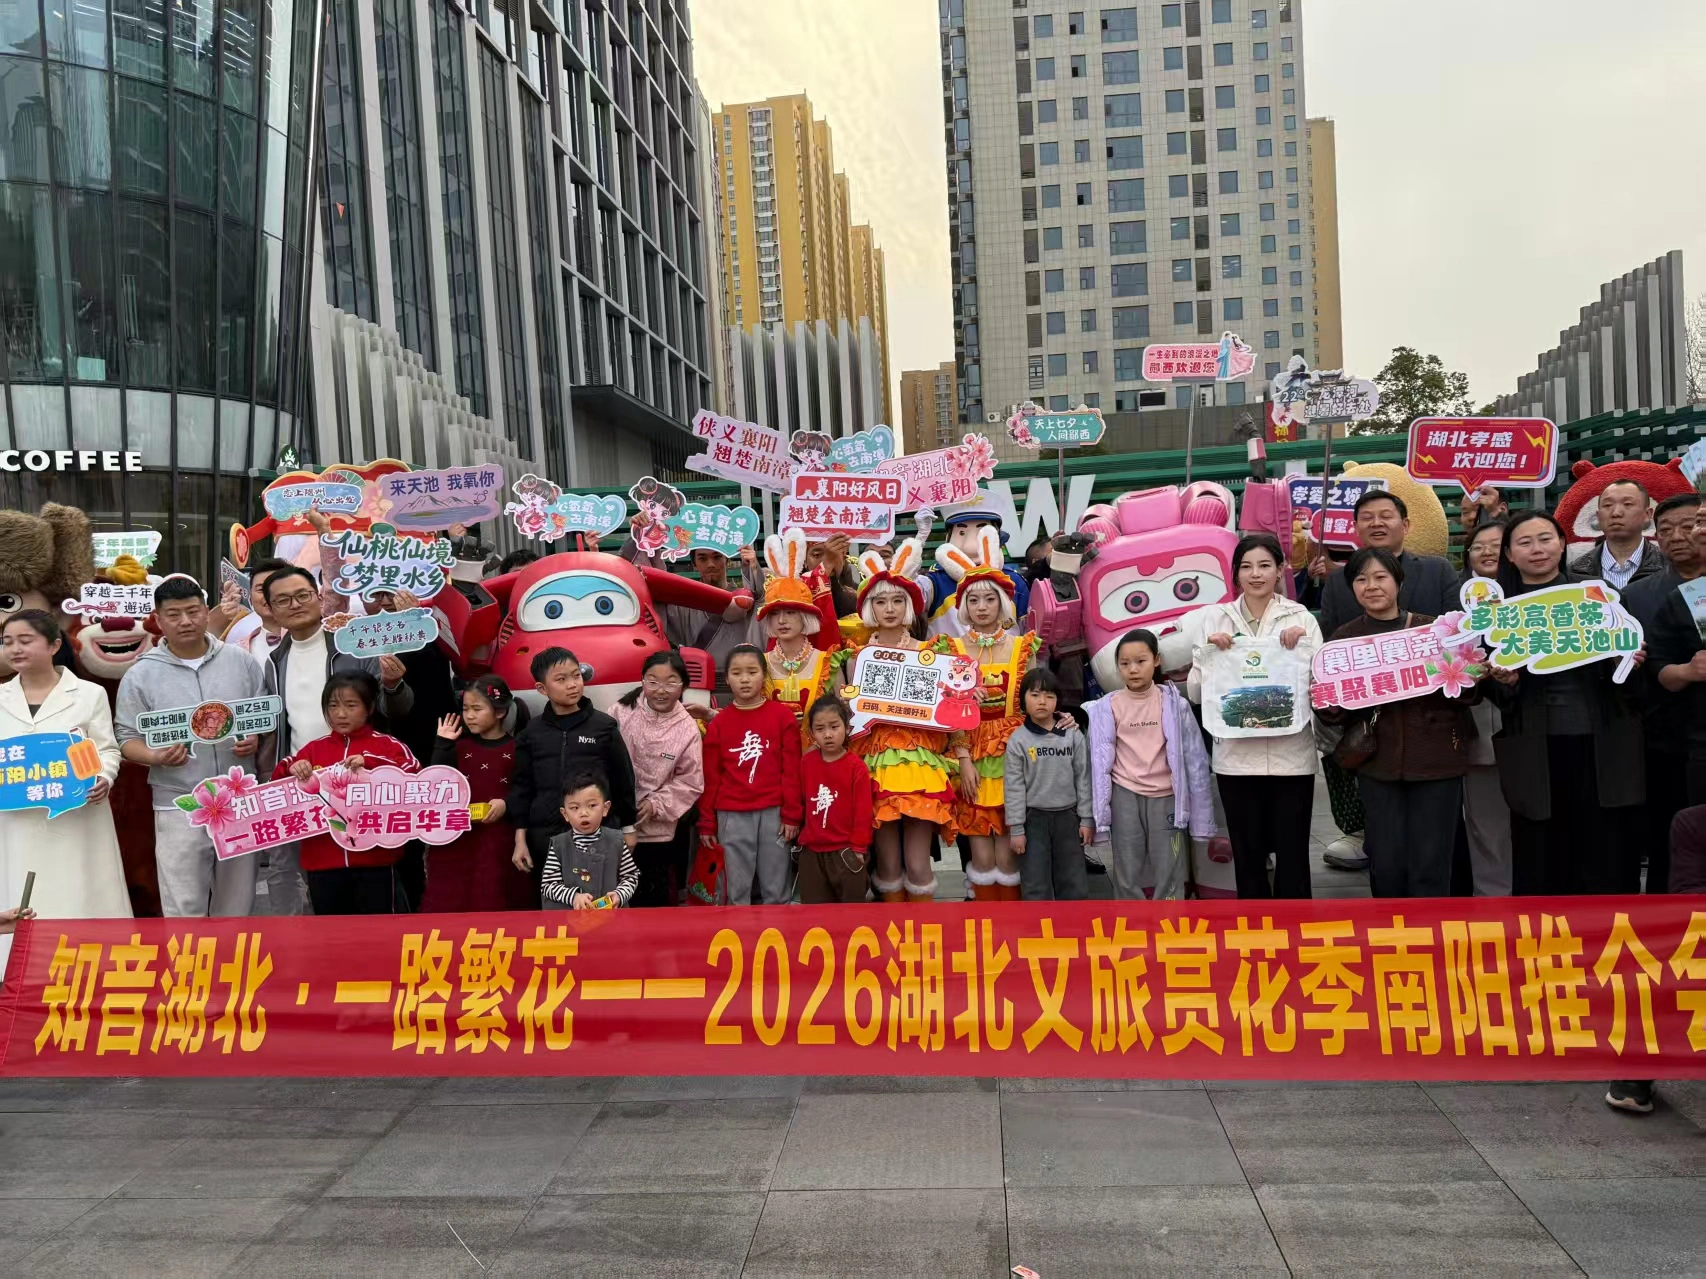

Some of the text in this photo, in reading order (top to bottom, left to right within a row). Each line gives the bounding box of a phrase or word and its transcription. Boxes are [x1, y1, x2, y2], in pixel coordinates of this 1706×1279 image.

[1149, 362, 1215, 373] 郧西欢迎您
[699, 416, 778, 455] 侠义襄阳
[1035, 418, 1077, 430] 天上七夕
[1426, 431, 1513, 448] 湖北孝感
[0, 450, 143, 472] COFFEE
[712, 442, 791, 480] 翘楚南漳
[872, 456, 955, 481] 音湖北
[390, 471, 495, 496] 来天池 我氧你
[815, 478, 898, 500] 襄阳好风日
[1292, 485, 1361, 505] 孝爱之城
[787, 505, 872, 527] 翘楚金南漳
[335, 531, 456, 567] 仙桃仙境
[333, 562, 444, 599] 梦里水乡
[84, 586, 153, 599] 穿越三千年
[124, 601, 152, 615] 邂逅
[1471, 601, 1604, 630] 多彩高香茶
[1500, 628, 1639, 655] 大美天池山
[873, 651, 906, 661] 2026
[1311, 664, 1429, 708] 襄聚襄阳
[1037, 747, 1073, 757] BROWN
[0, 760, 68, 786] 阳小镇
[27, 782, 63, 801] 等你
[345, 780, 460, 807] 同心聚力
[357, 809, 471, 834] 共启华章
